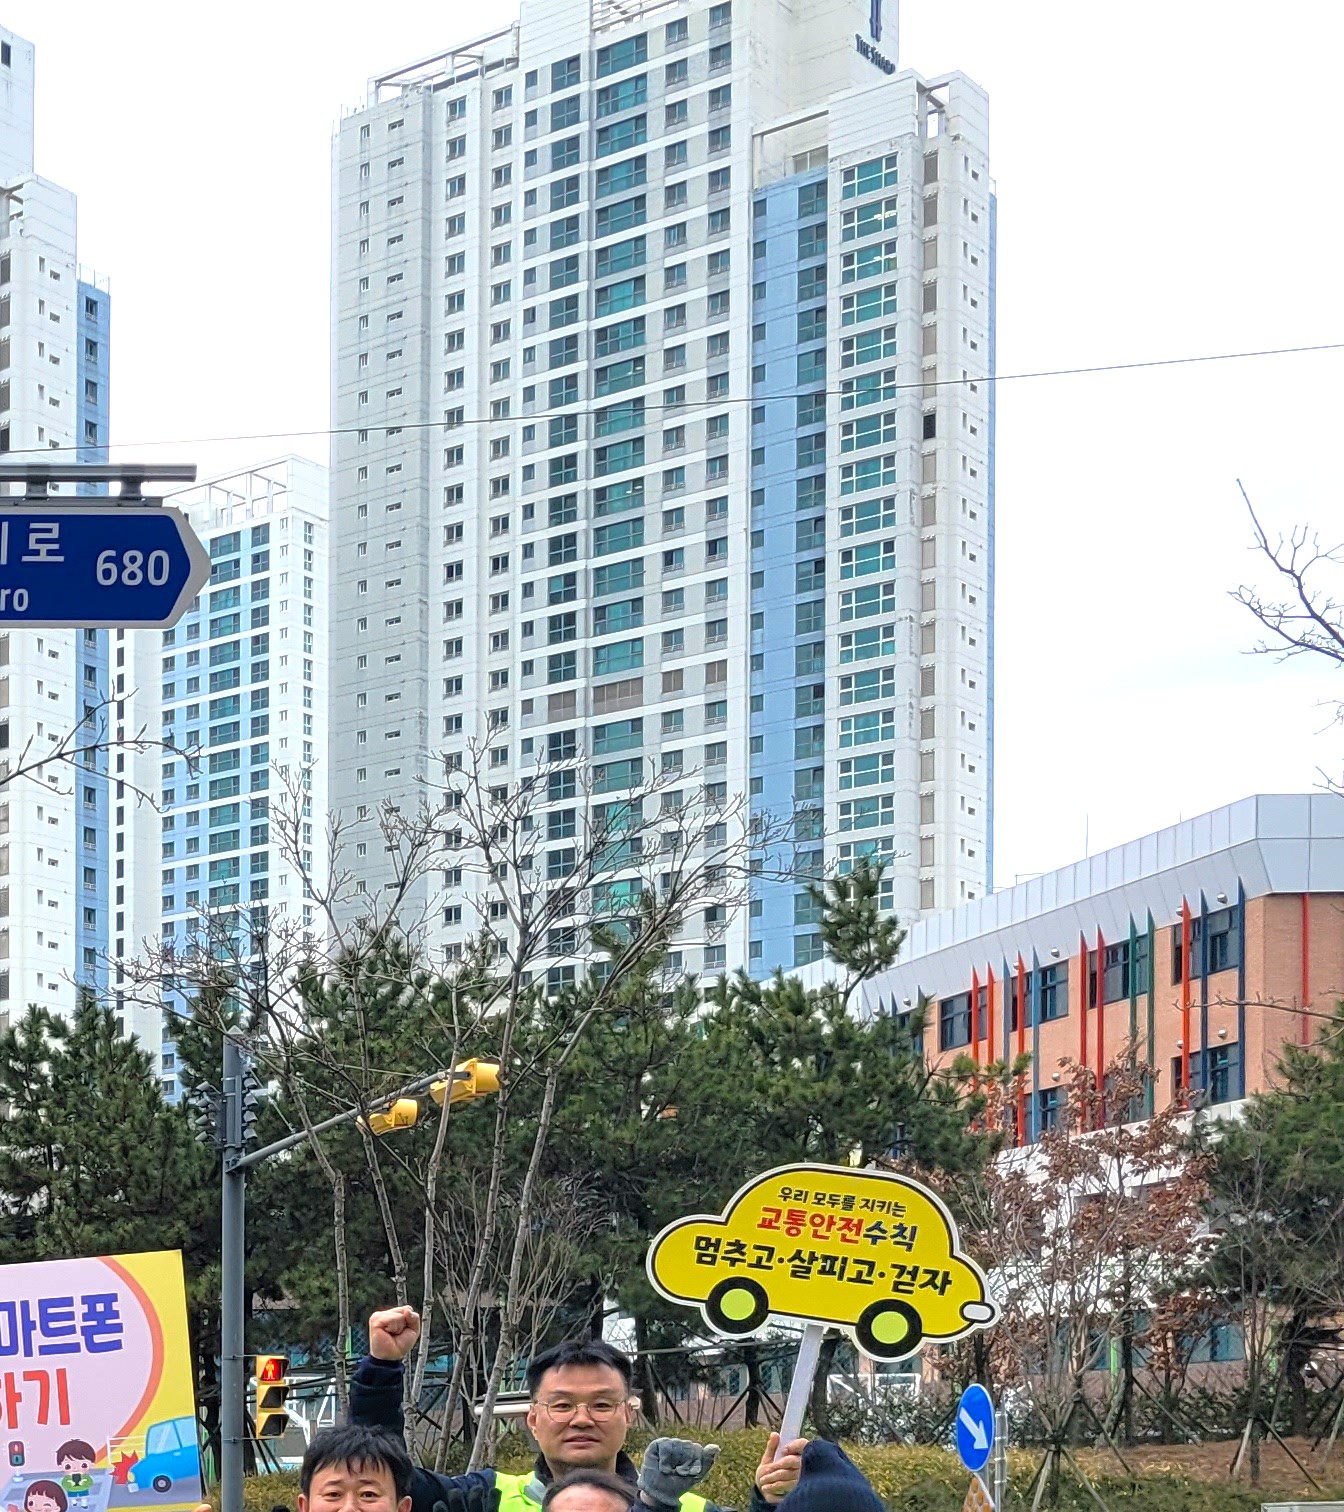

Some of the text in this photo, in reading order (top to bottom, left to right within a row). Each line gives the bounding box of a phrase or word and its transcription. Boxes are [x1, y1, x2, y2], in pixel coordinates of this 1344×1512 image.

[95, 550, 170, 586] 680
[778, 1187, 907, 1218] 우리 모두를 지키는
[757, 1206, 918, 1252] 교통안전수칙
